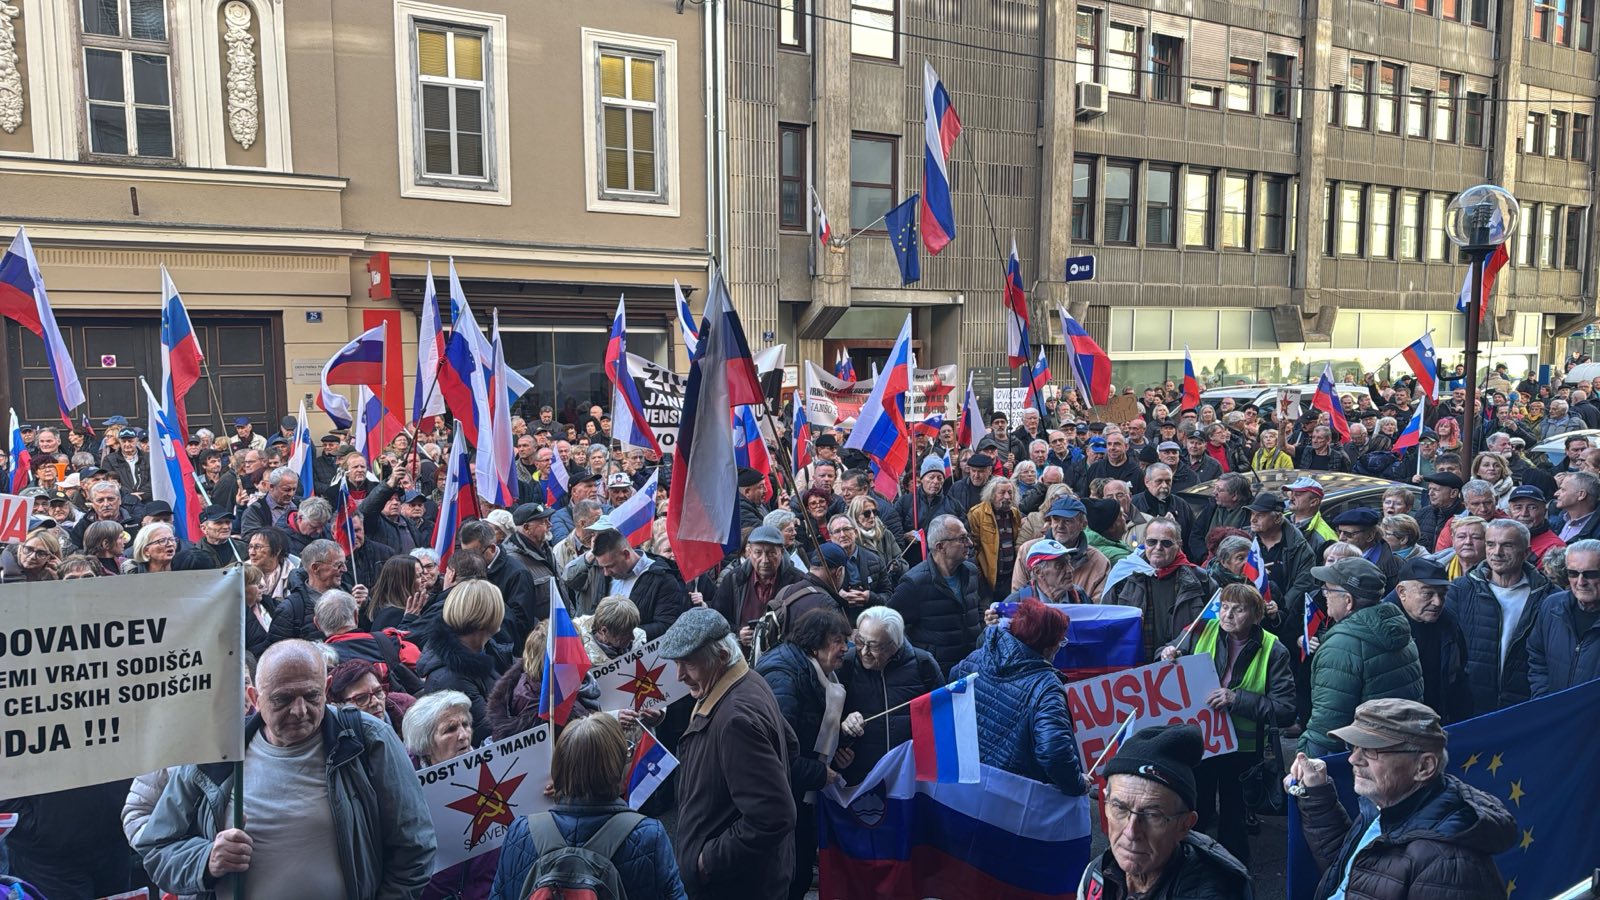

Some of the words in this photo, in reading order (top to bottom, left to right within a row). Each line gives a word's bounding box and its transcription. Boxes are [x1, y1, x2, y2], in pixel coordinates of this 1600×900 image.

[643, 408, 682, 424] VENS
[46, 661, 108, 684] VRATI
[117, 649, 203, 677] SODIŠČA
[624, 649, 643, 665] VAS
[4, 688, 110, 717] CELJSKIH
[118, 673, 212, 704] SODIŠČIH
[85, 717, 120, 747] !!!
[463, 749, 494, 770] VAS
